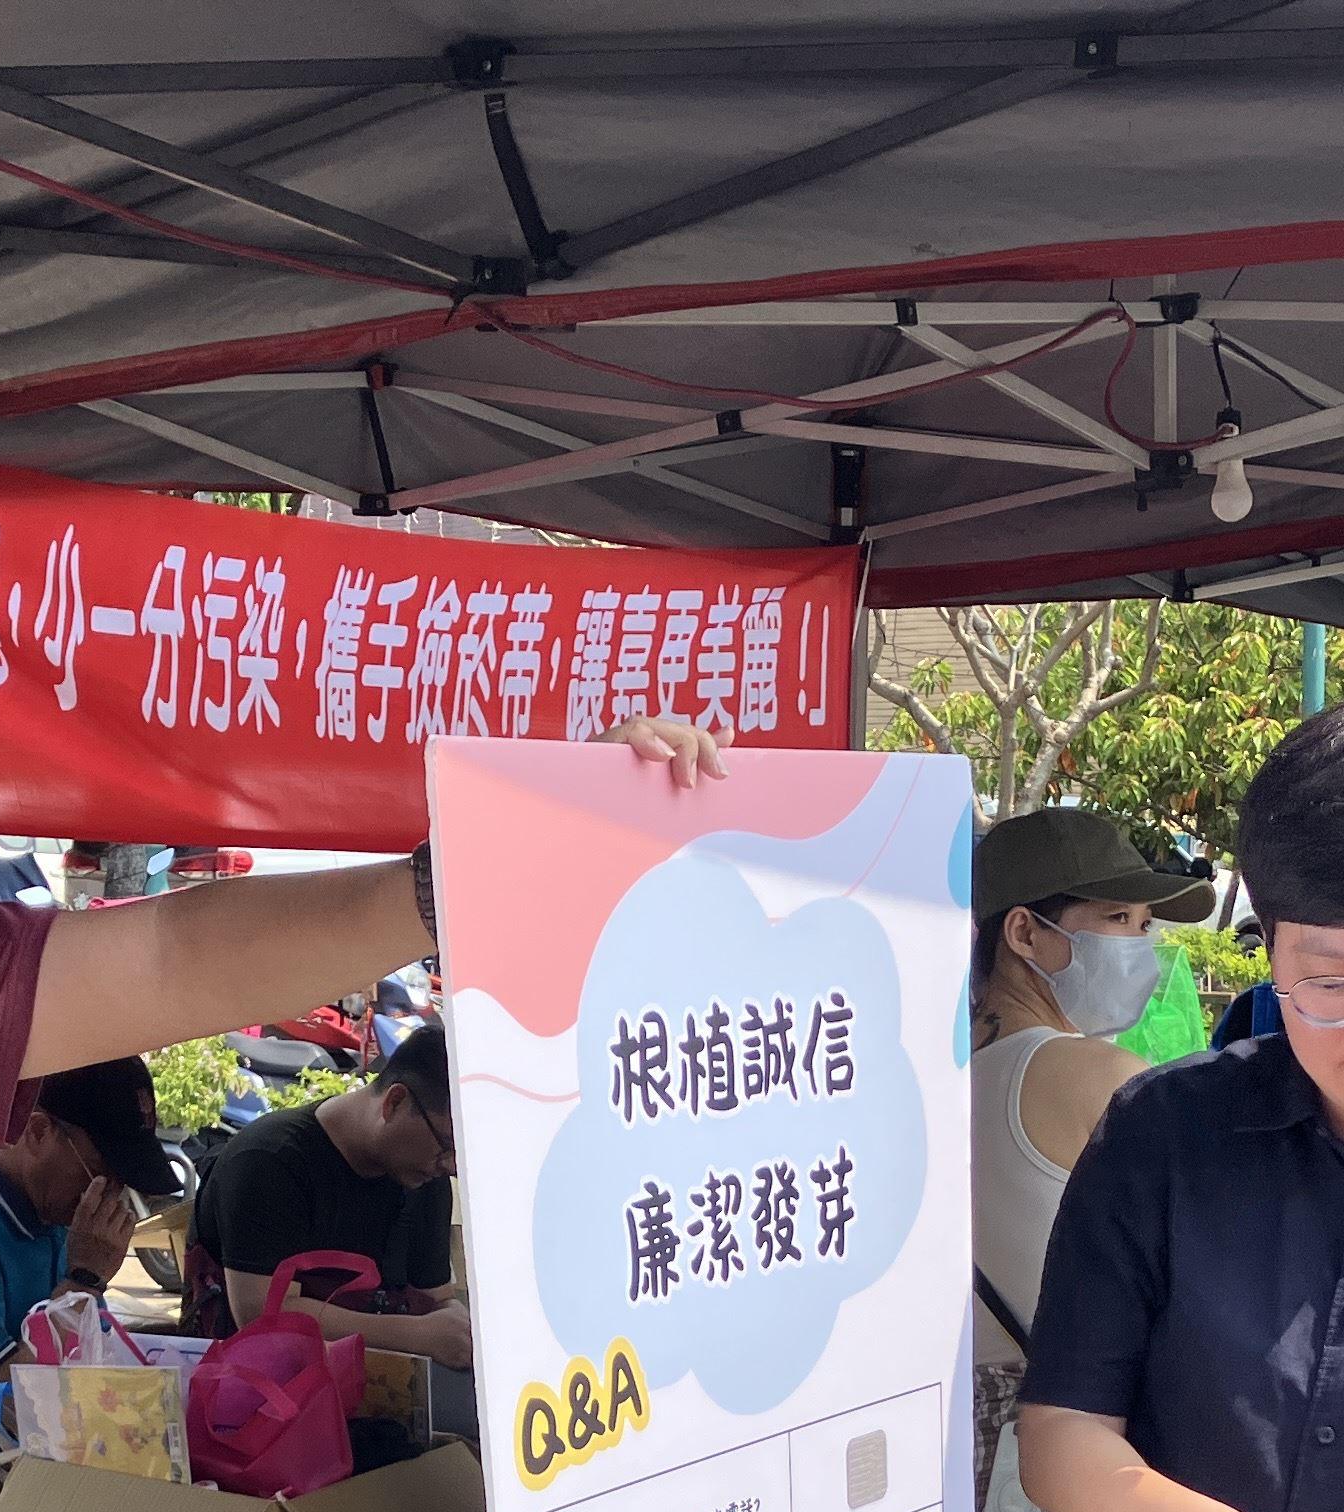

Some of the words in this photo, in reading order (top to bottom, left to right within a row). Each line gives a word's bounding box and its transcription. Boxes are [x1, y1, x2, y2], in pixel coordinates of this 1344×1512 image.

[610, 992, 854, 1123] 根植誠信
[625, 1145, 855, 1302] 廉潔發芽
[521, 1351, 643, 1476] Q&A
